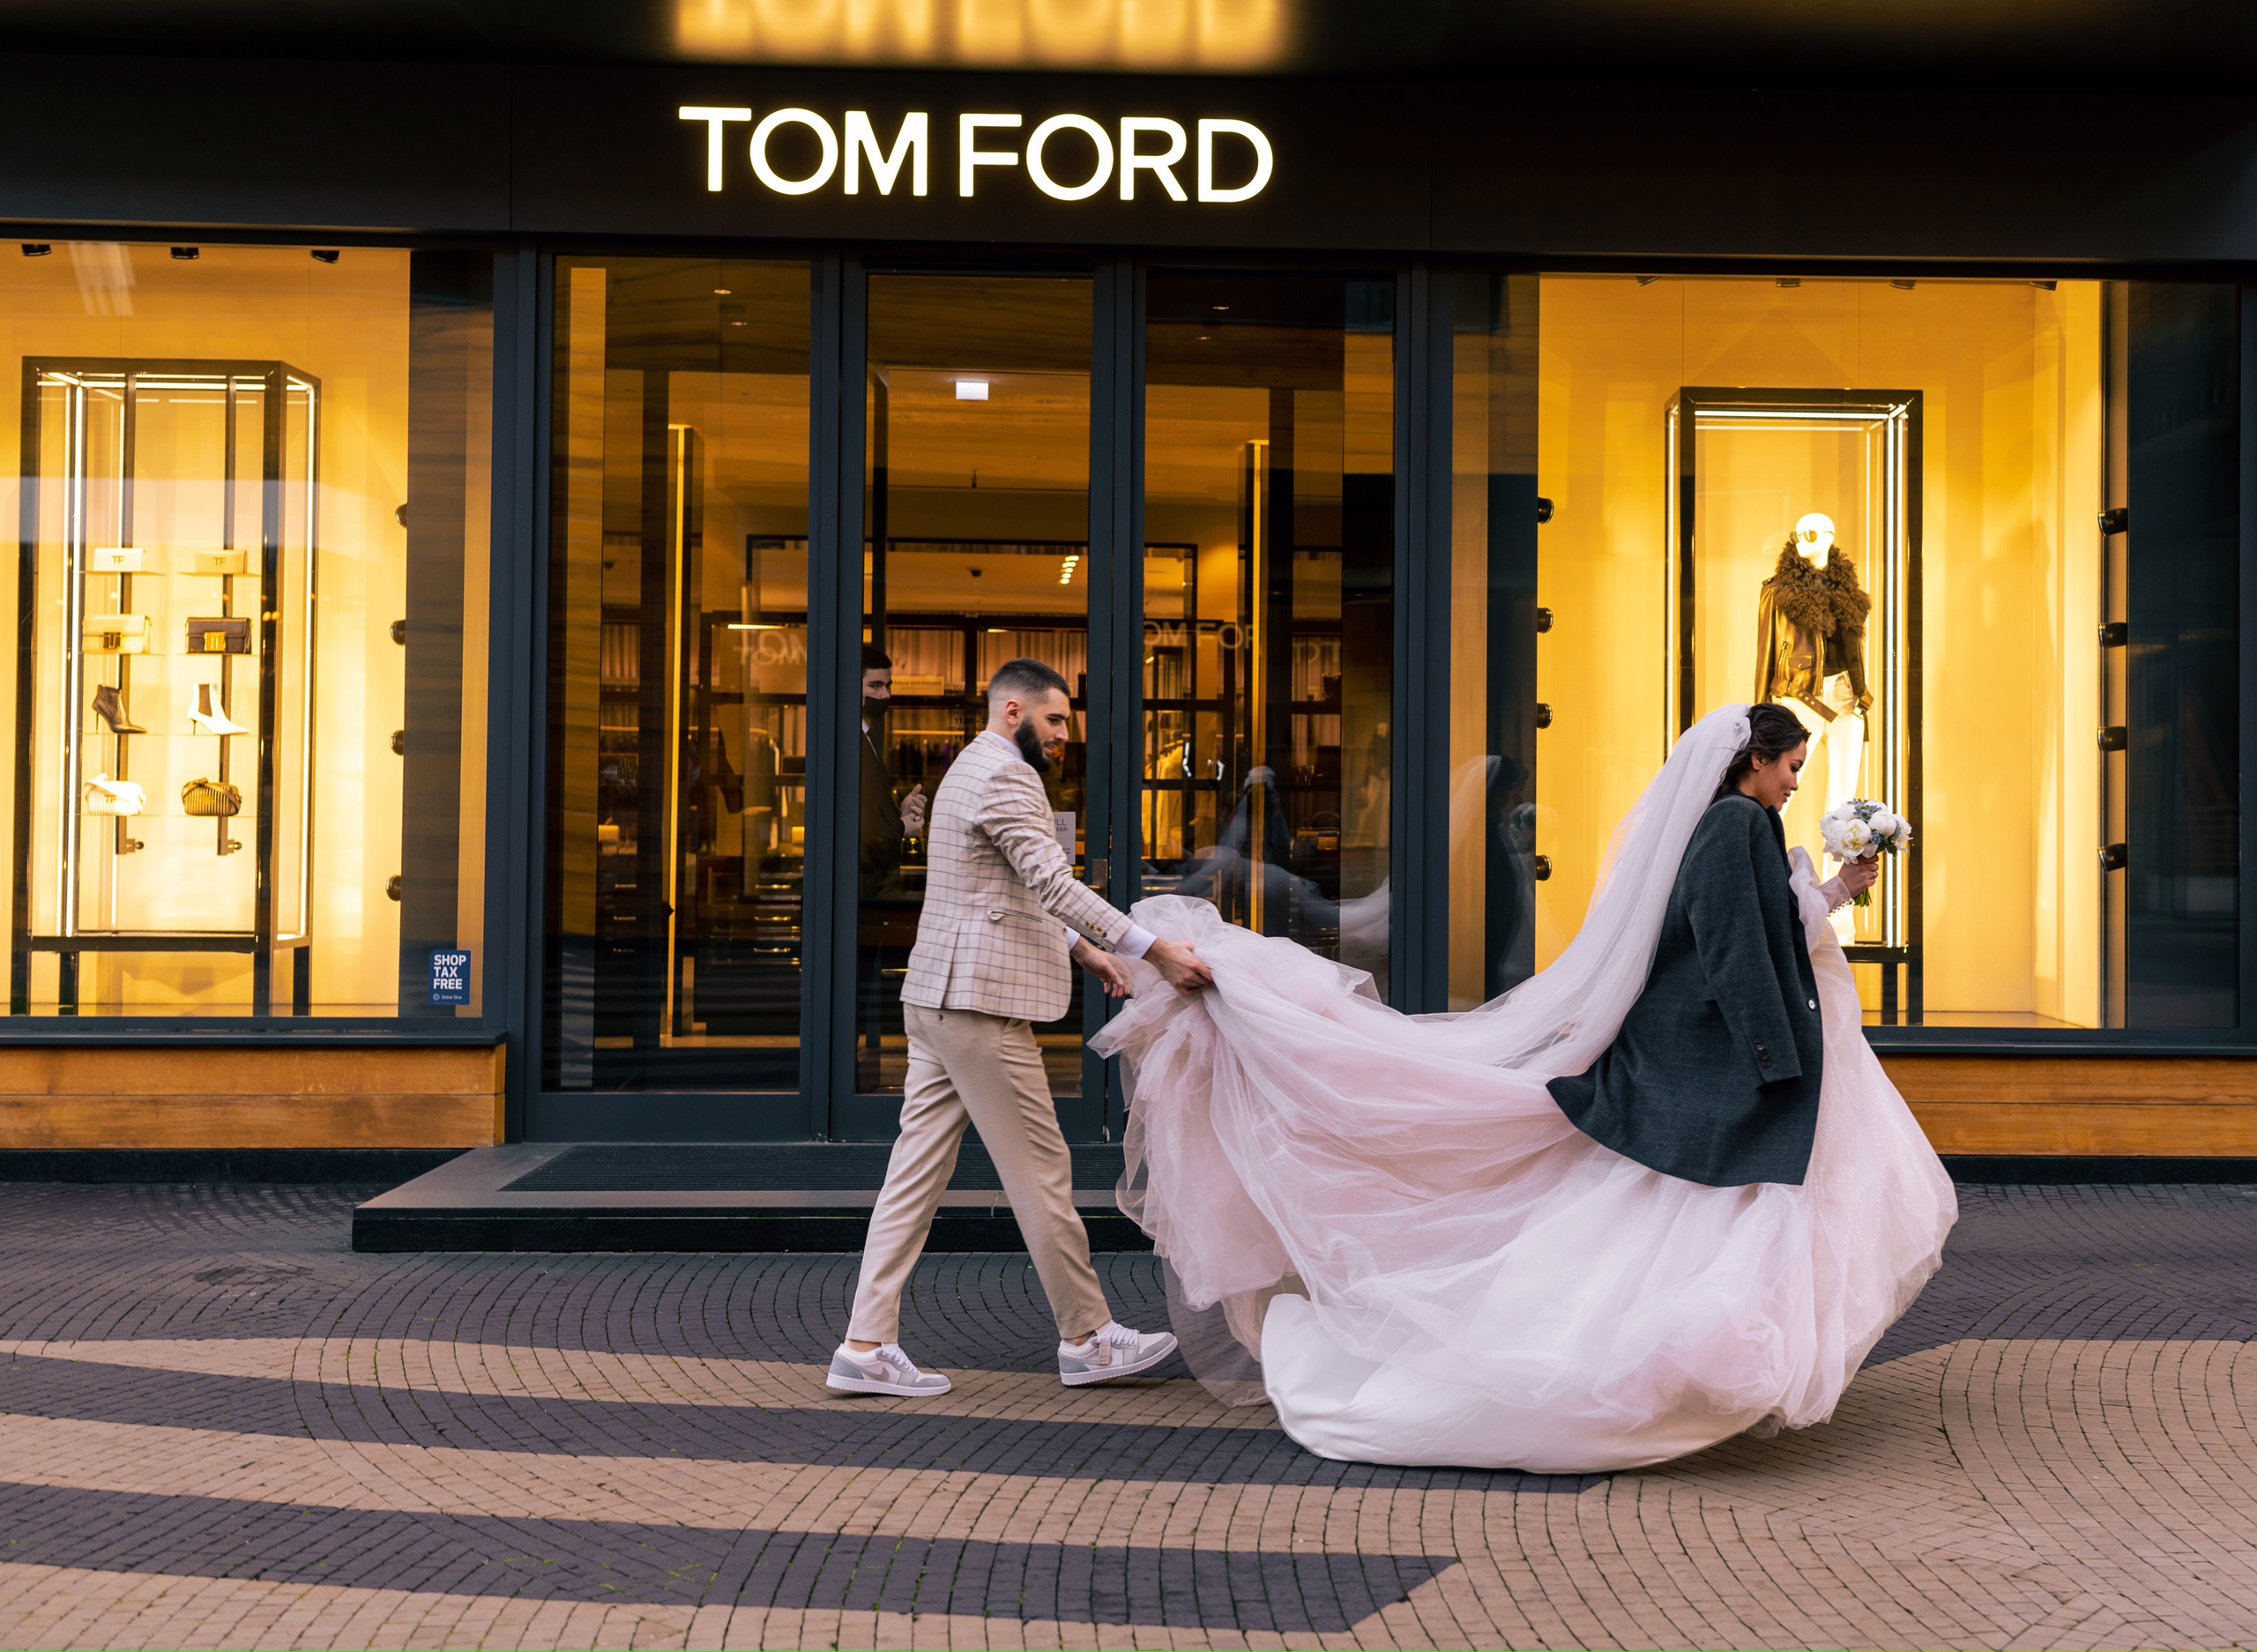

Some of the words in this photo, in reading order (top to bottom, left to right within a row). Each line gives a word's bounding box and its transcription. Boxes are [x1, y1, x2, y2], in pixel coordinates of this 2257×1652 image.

[678, 106, 928, 196] TOM
[959, 113, 1274, 202] FORD
[111, 555, 125, 564] TF
[213, 556, 227, 567] TF
[434, 954, 467, 966] SHOP
[433, 966, 458, 978] TAX
[433, 979, 463, 990] FREE
